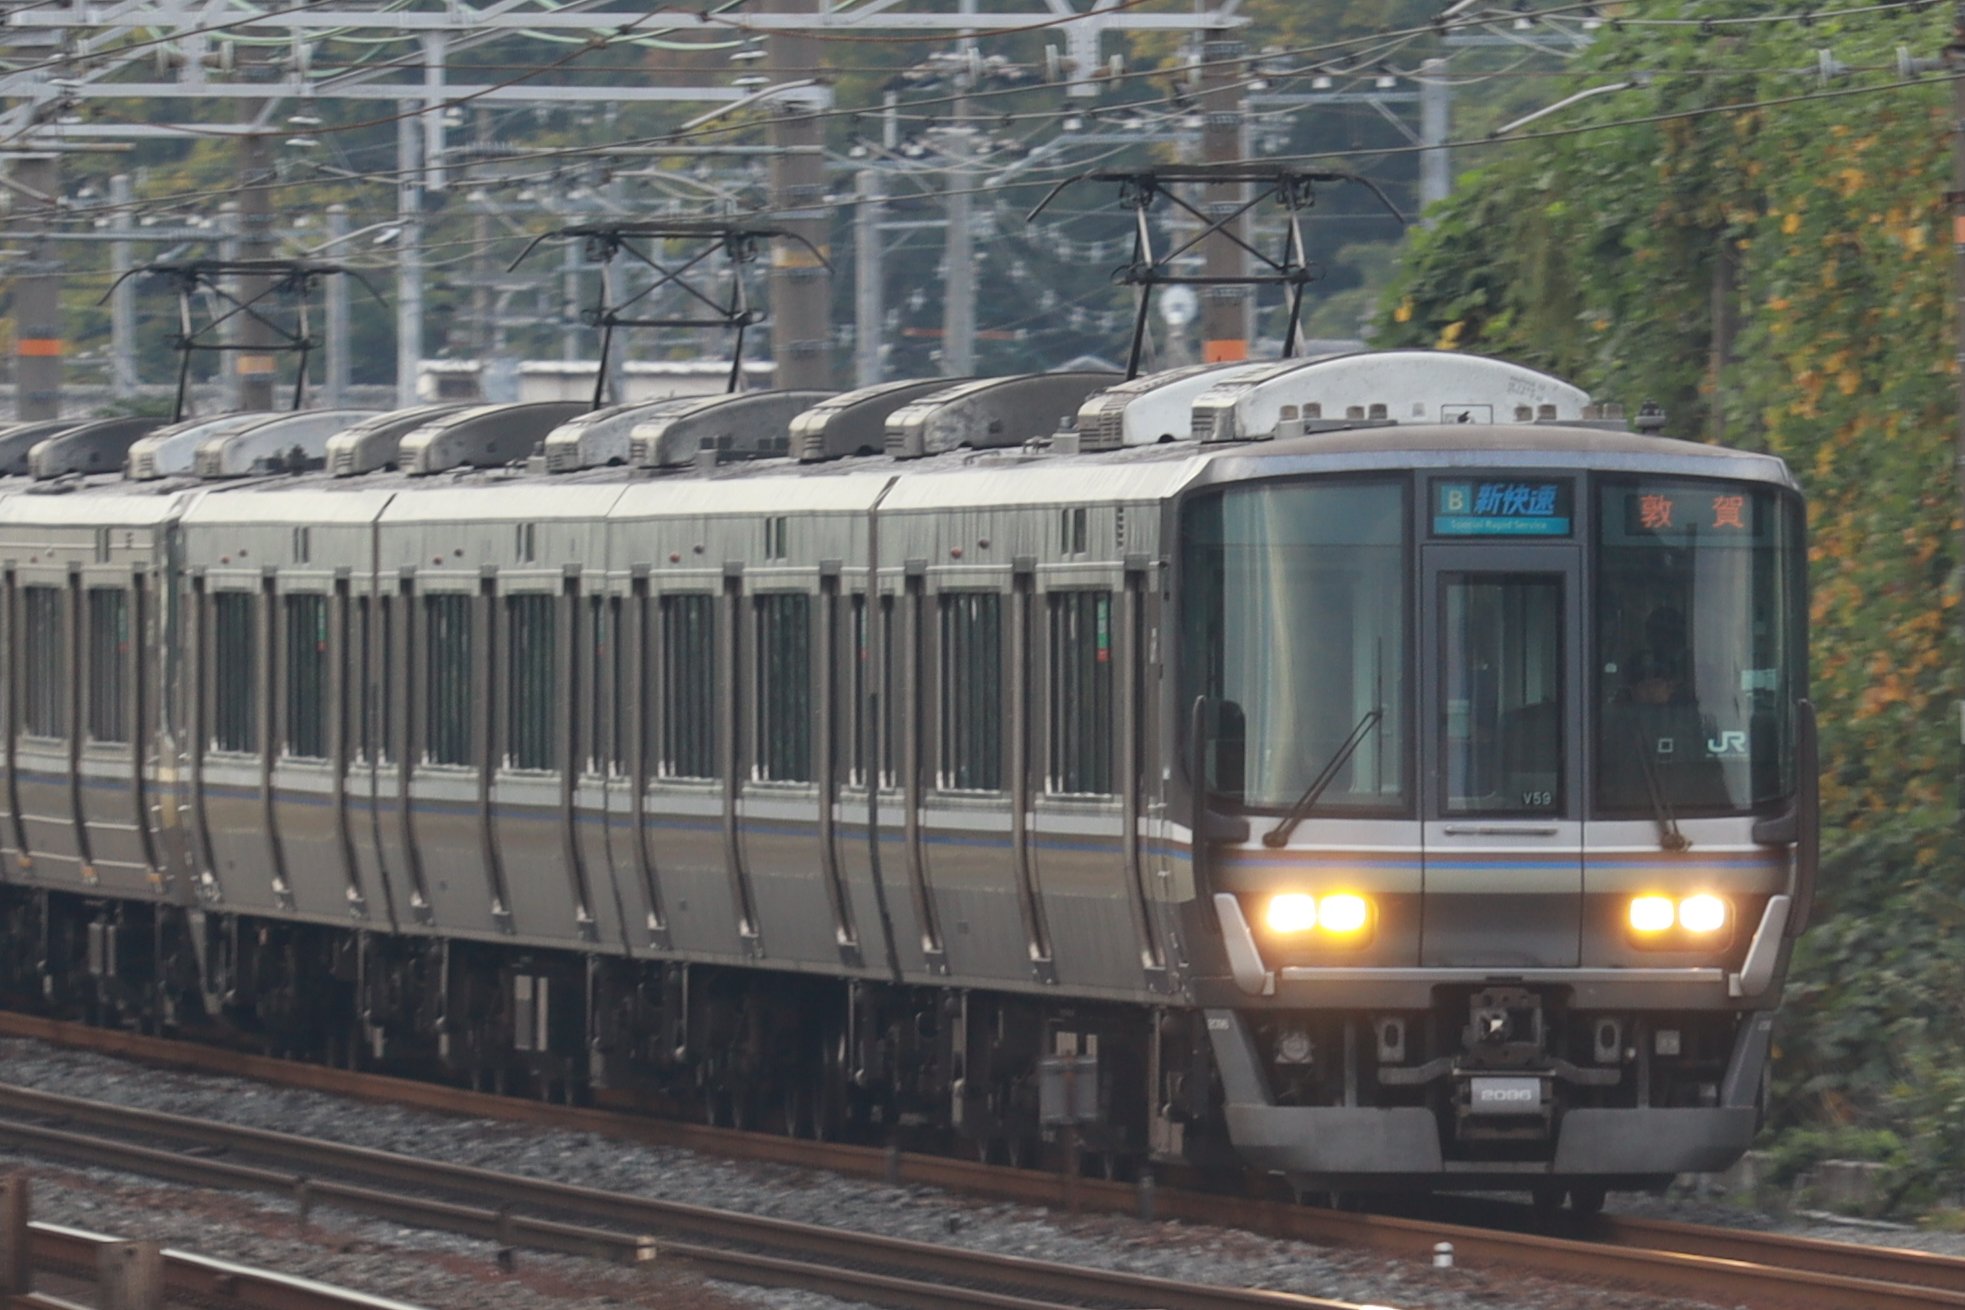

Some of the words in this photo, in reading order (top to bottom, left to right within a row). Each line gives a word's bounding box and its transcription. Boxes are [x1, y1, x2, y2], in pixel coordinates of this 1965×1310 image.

[1447, 489, 1463, 512] B
[1473, 483, 1558, 516] 新快速
[1640, 495, 1746, 528] 敦賀
[1450, 520, 1483, 530] Special
[1485, 520, 1512, 531] Rapid
[1514, 520, 1547, 530] Service
[1707, 730, 1746, 753] JR
[1522, 791, 1552, 805] V59
